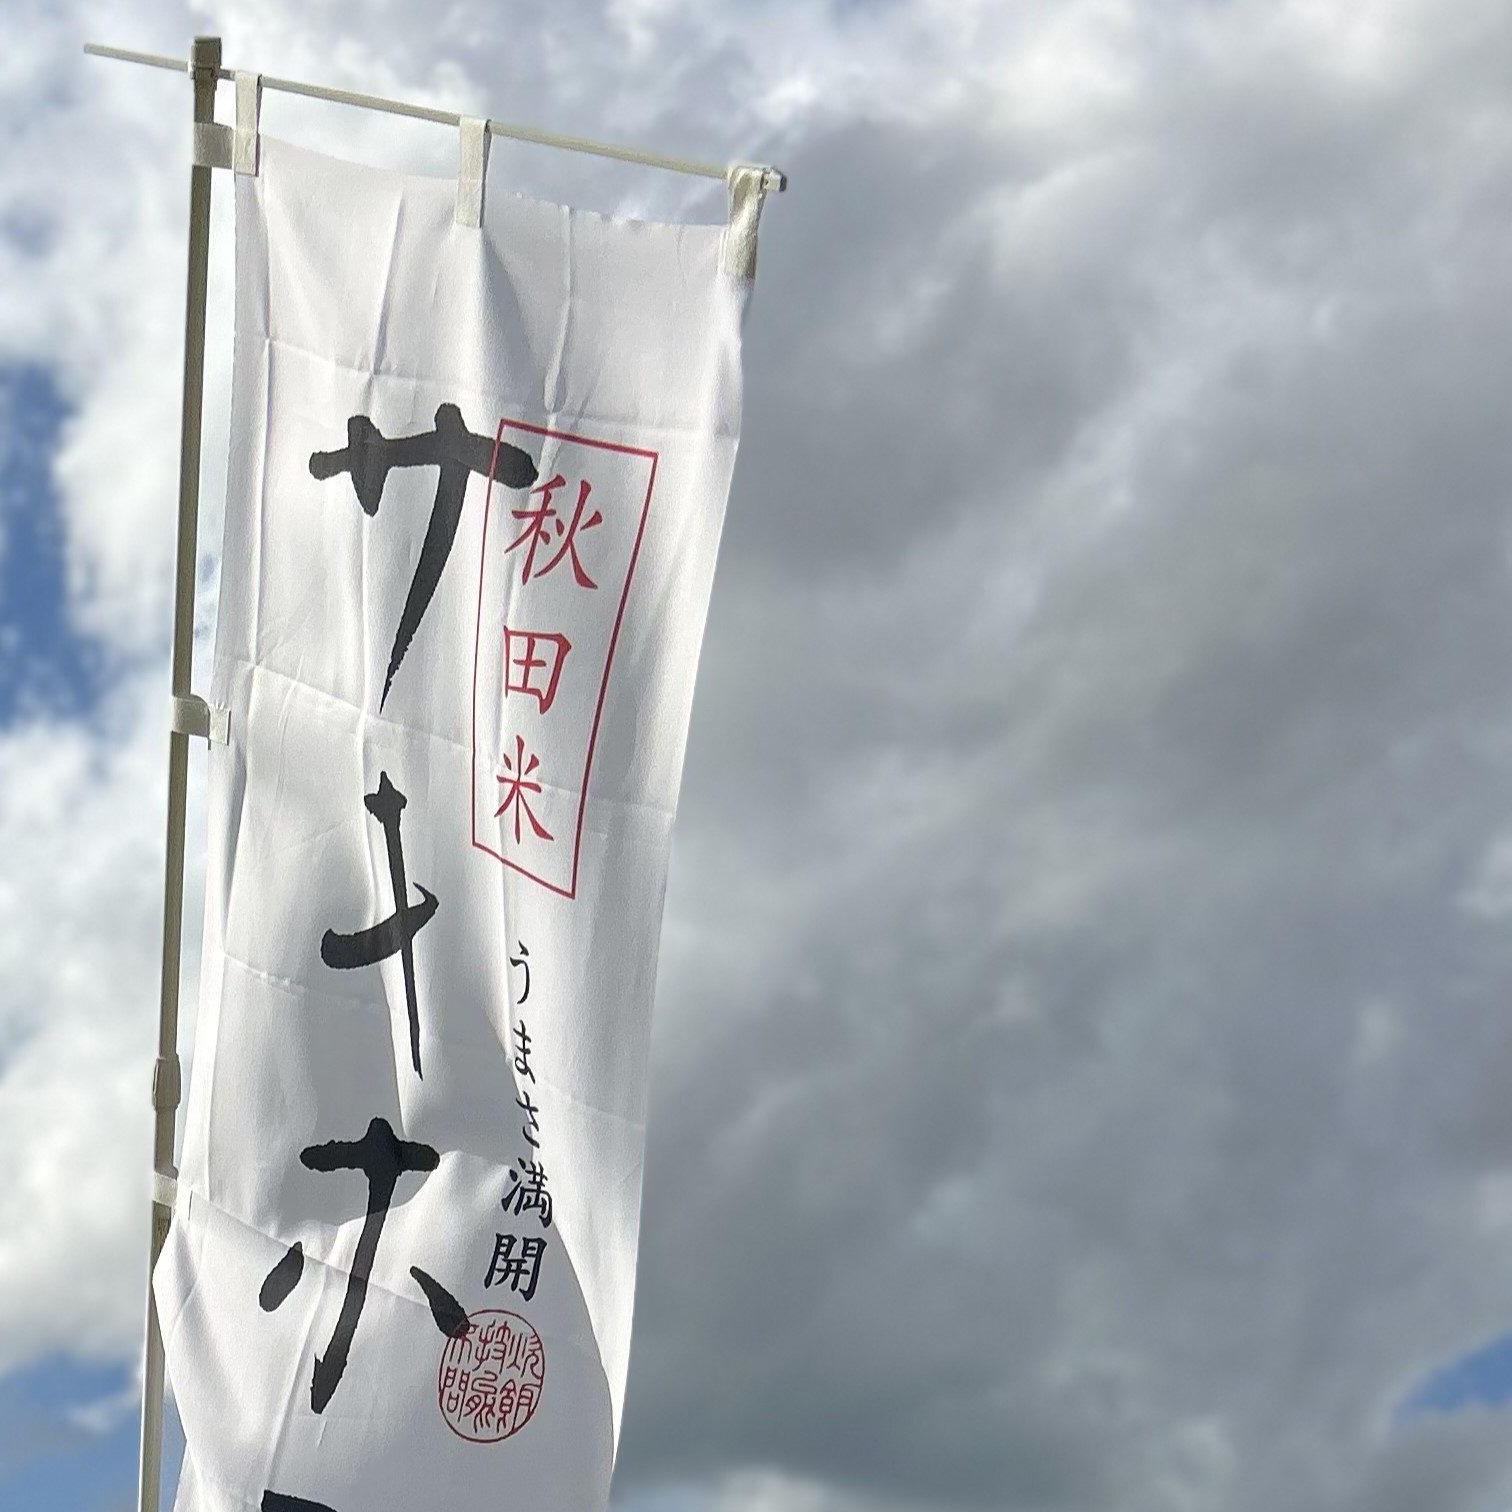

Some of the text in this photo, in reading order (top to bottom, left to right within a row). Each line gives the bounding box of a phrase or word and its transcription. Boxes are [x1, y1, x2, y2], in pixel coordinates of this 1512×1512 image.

[493, 473, 603, 845] 秋田米
[483, 940, 553, 1302] うまさ満開
